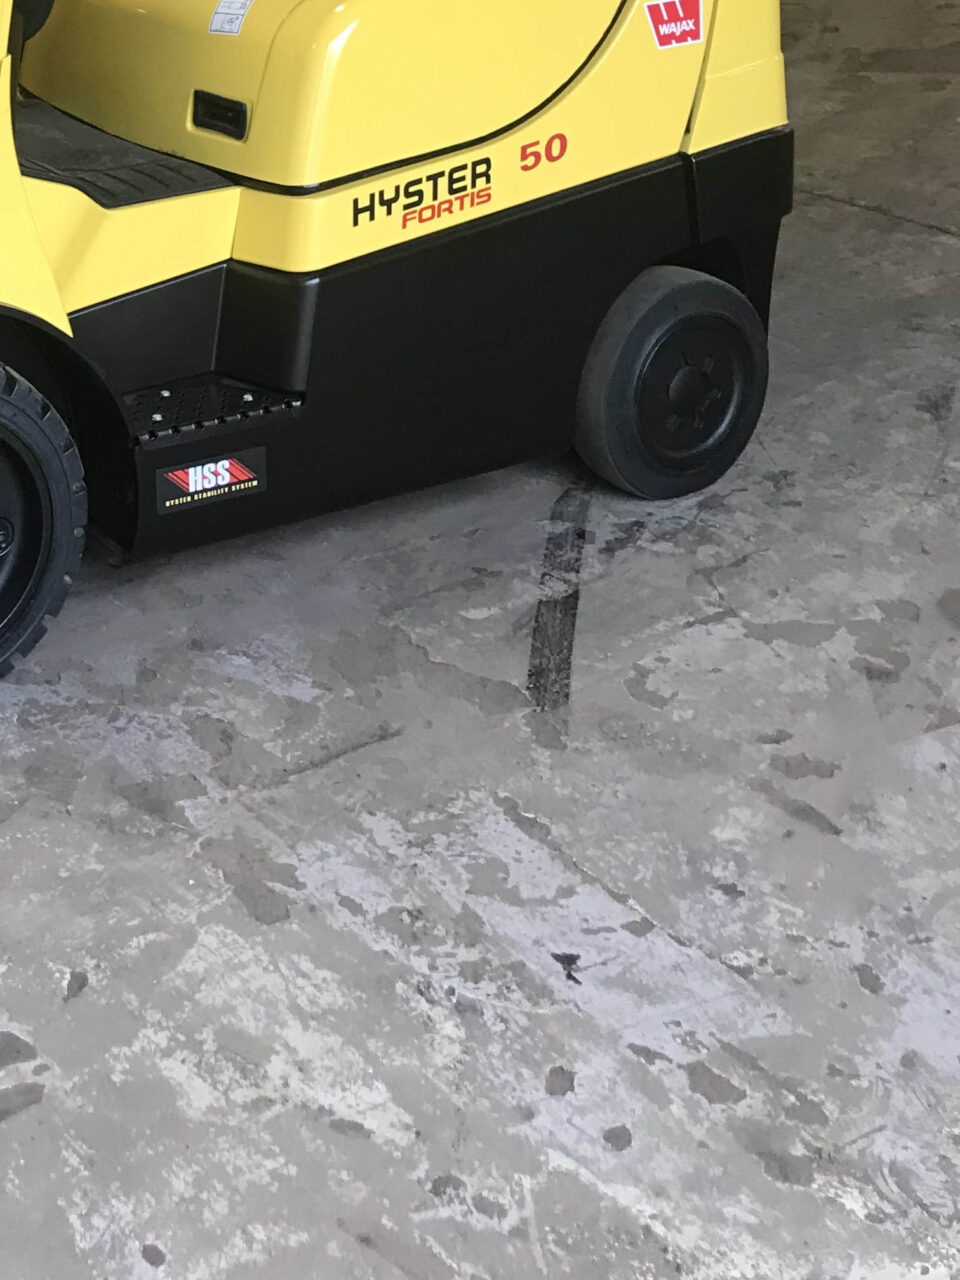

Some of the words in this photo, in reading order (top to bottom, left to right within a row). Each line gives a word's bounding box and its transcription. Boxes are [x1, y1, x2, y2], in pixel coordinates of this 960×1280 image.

[658, 19, 696, 36] WAJAX
[520, 133, 568, 172] 50
[352, 157, 492, 227] HYSTER
[401, 187, 492, 230] FORTIS
[188, 460, 231, 493] HSS
[232, 480, 258, 492] SYSTEM
